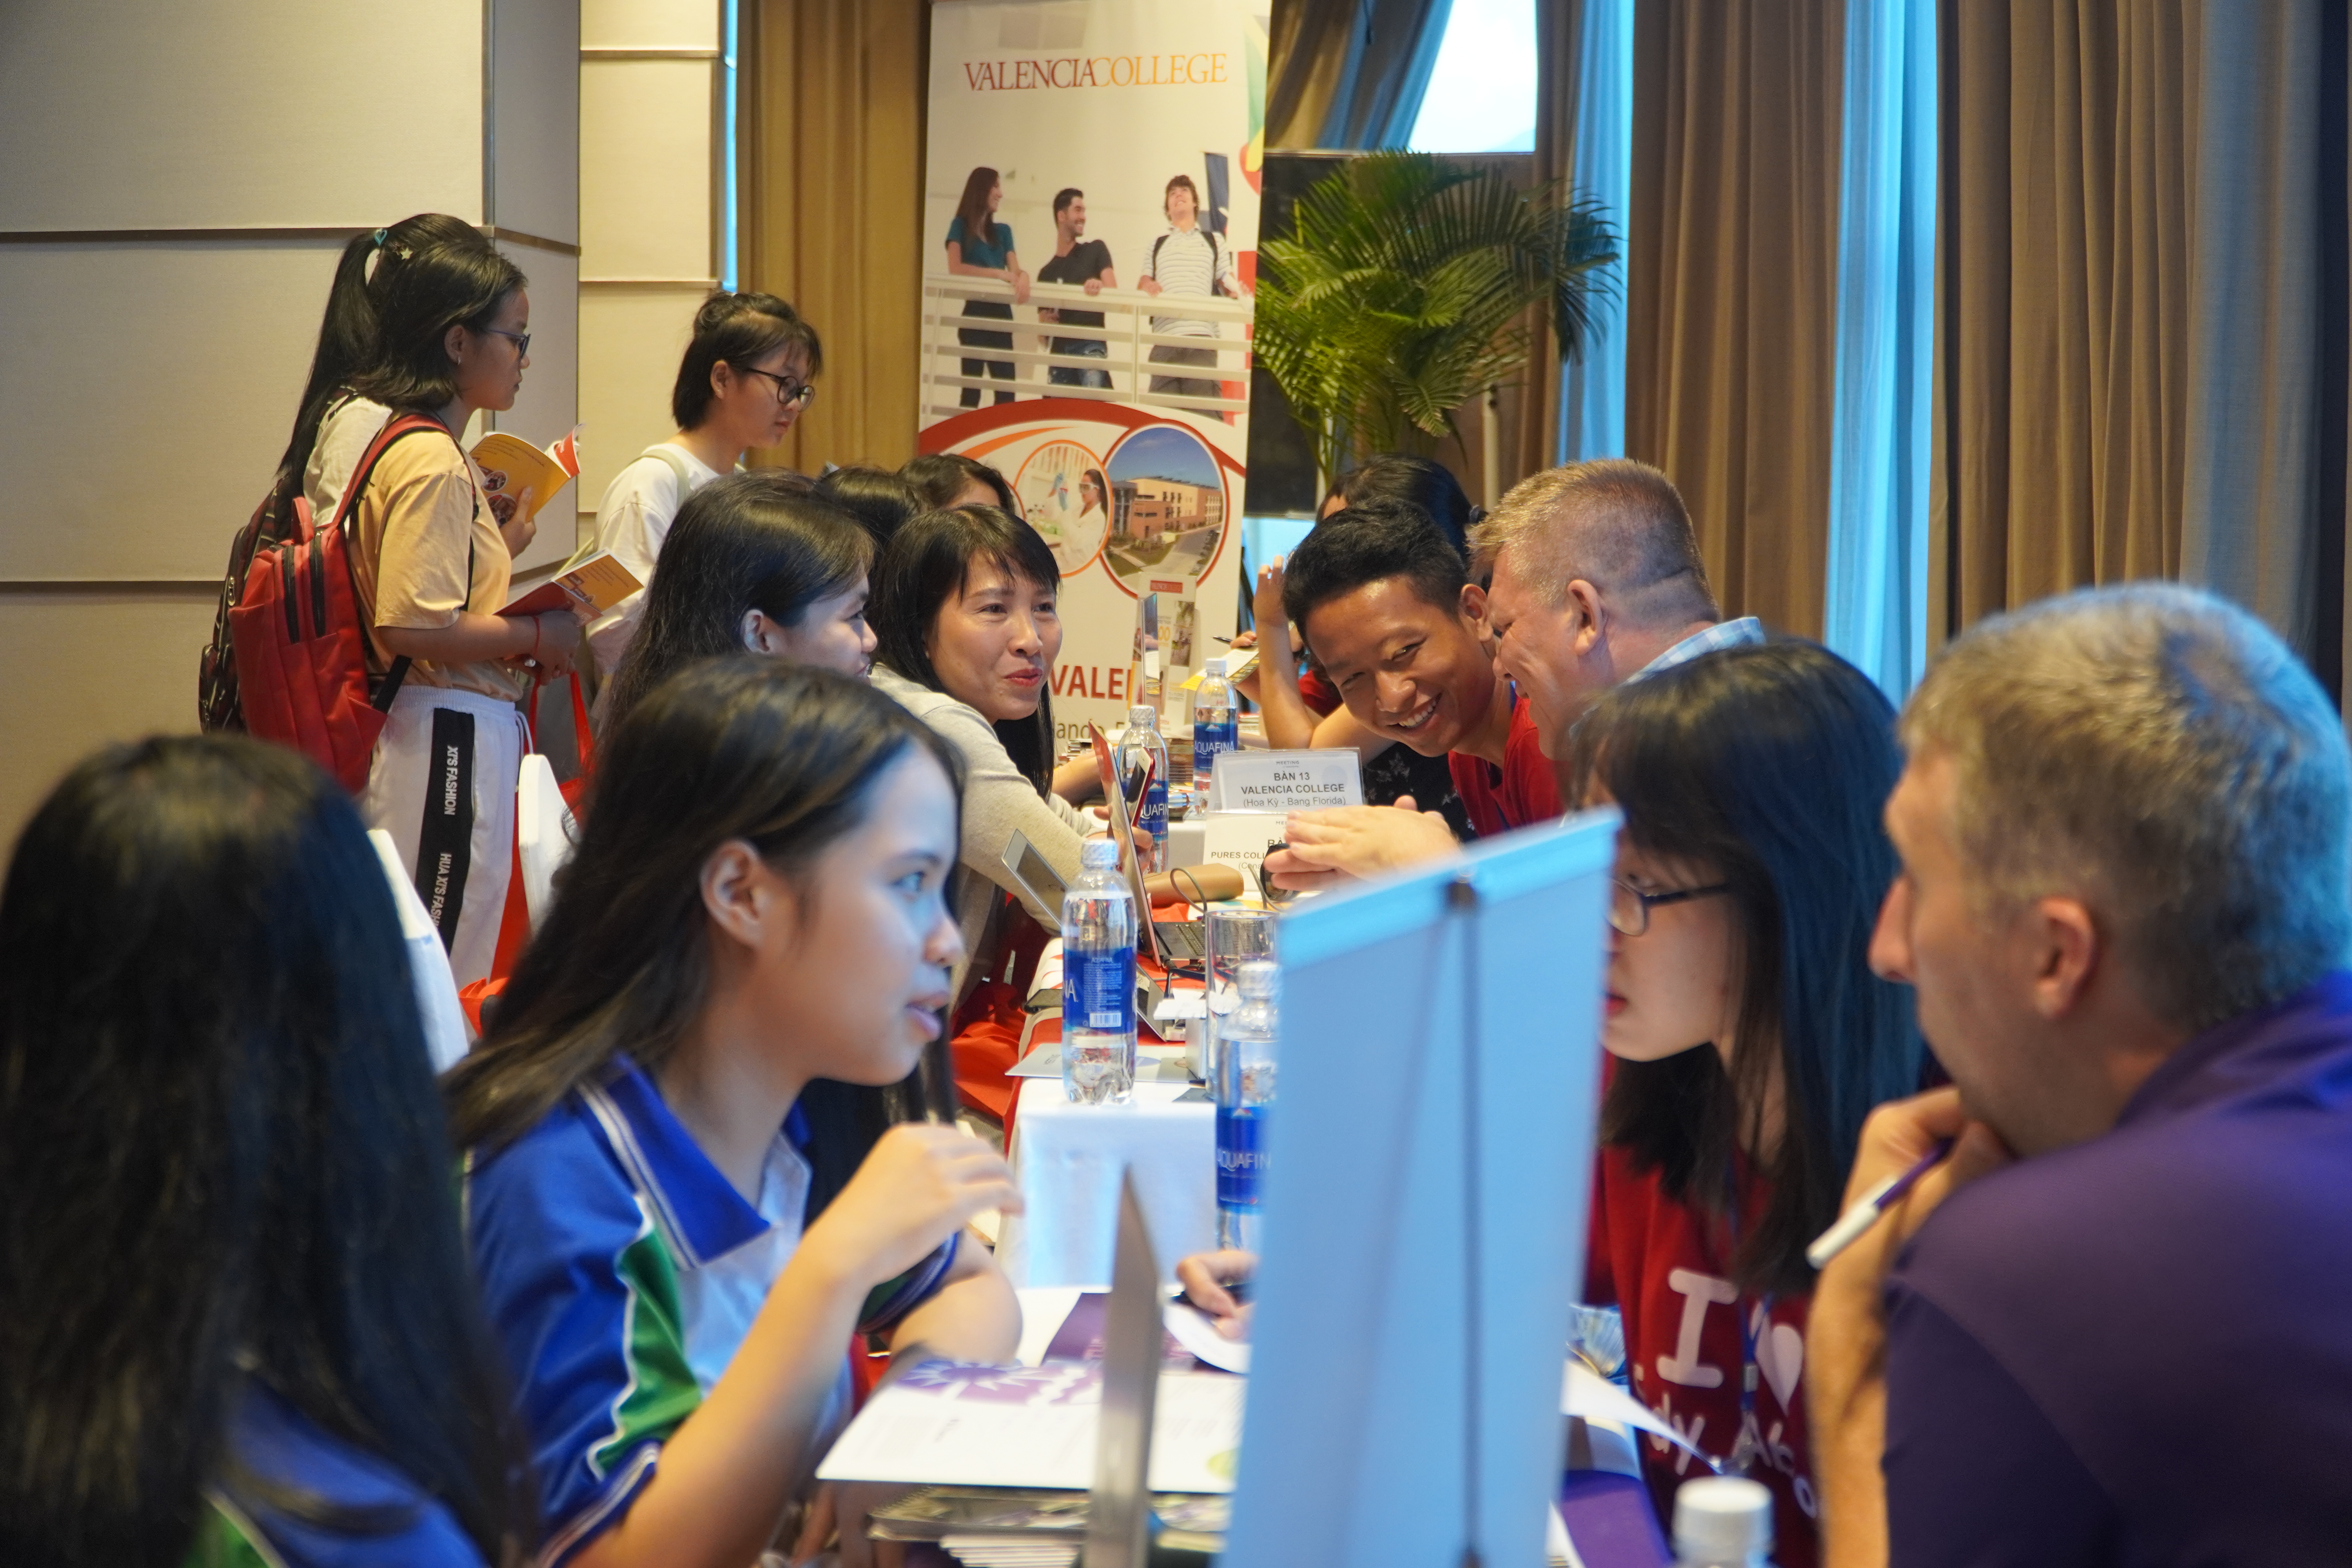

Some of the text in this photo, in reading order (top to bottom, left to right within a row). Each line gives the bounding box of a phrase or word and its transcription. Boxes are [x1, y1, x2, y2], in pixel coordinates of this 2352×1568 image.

[1048, 665, 1132, 701] VALE
[1194, 740, 1235, 755] AQUAFINA
[1274, 771, 1296, 781] BÀN
[444, 768, 458, 815] FASHION
[1241, 784, 1345, 795] VALENCIA COLLEGE
[1243, 799, 1265, 808] (Hoa
[1287, 797, 1310, 807] Bang
[1313, 797, 1346, 806] Florida)
[438, 853, 452, 874] HUA
[1656, 1267, 1739, 1388] I
